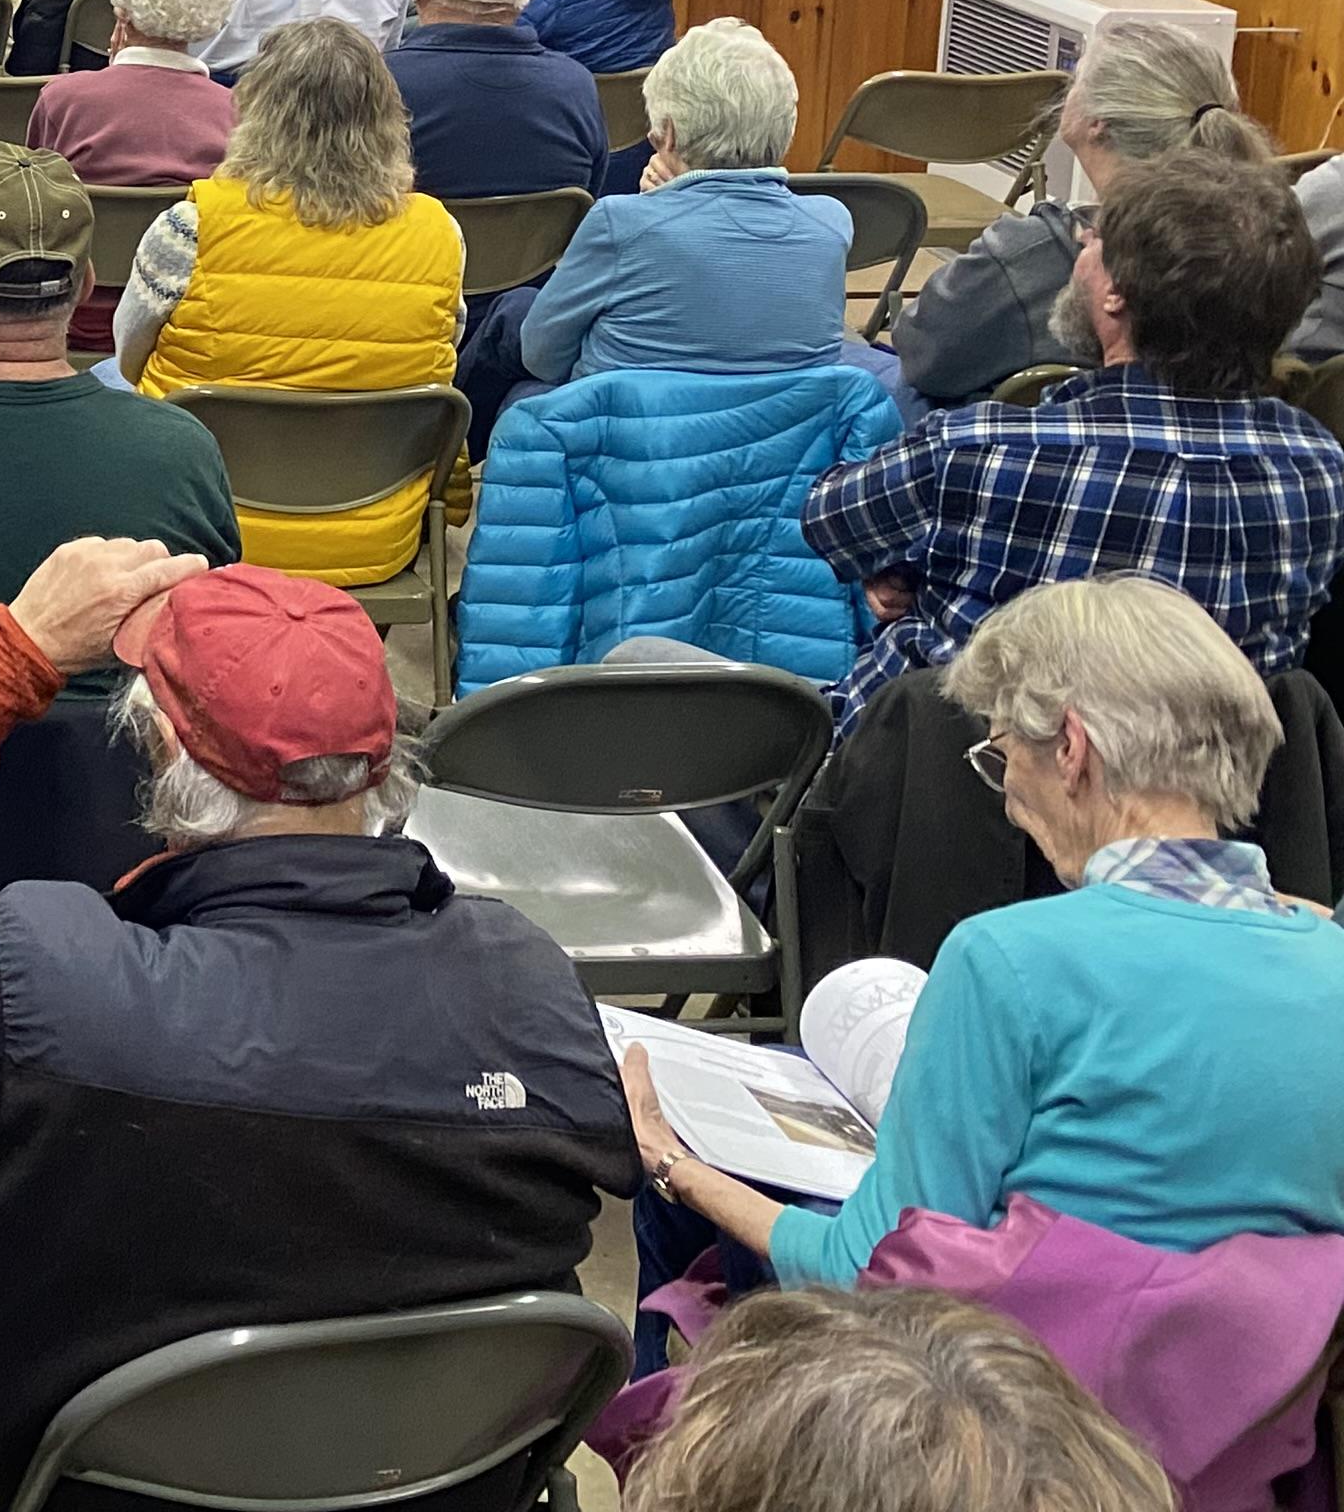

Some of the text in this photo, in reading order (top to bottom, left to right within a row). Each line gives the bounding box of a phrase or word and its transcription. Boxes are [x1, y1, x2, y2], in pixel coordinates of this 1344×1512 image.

[481, 1072, 504, 1085] THE
[466, 1084, 505, 1098] NORTH
[478, 1097, 505, 1110] FACE
